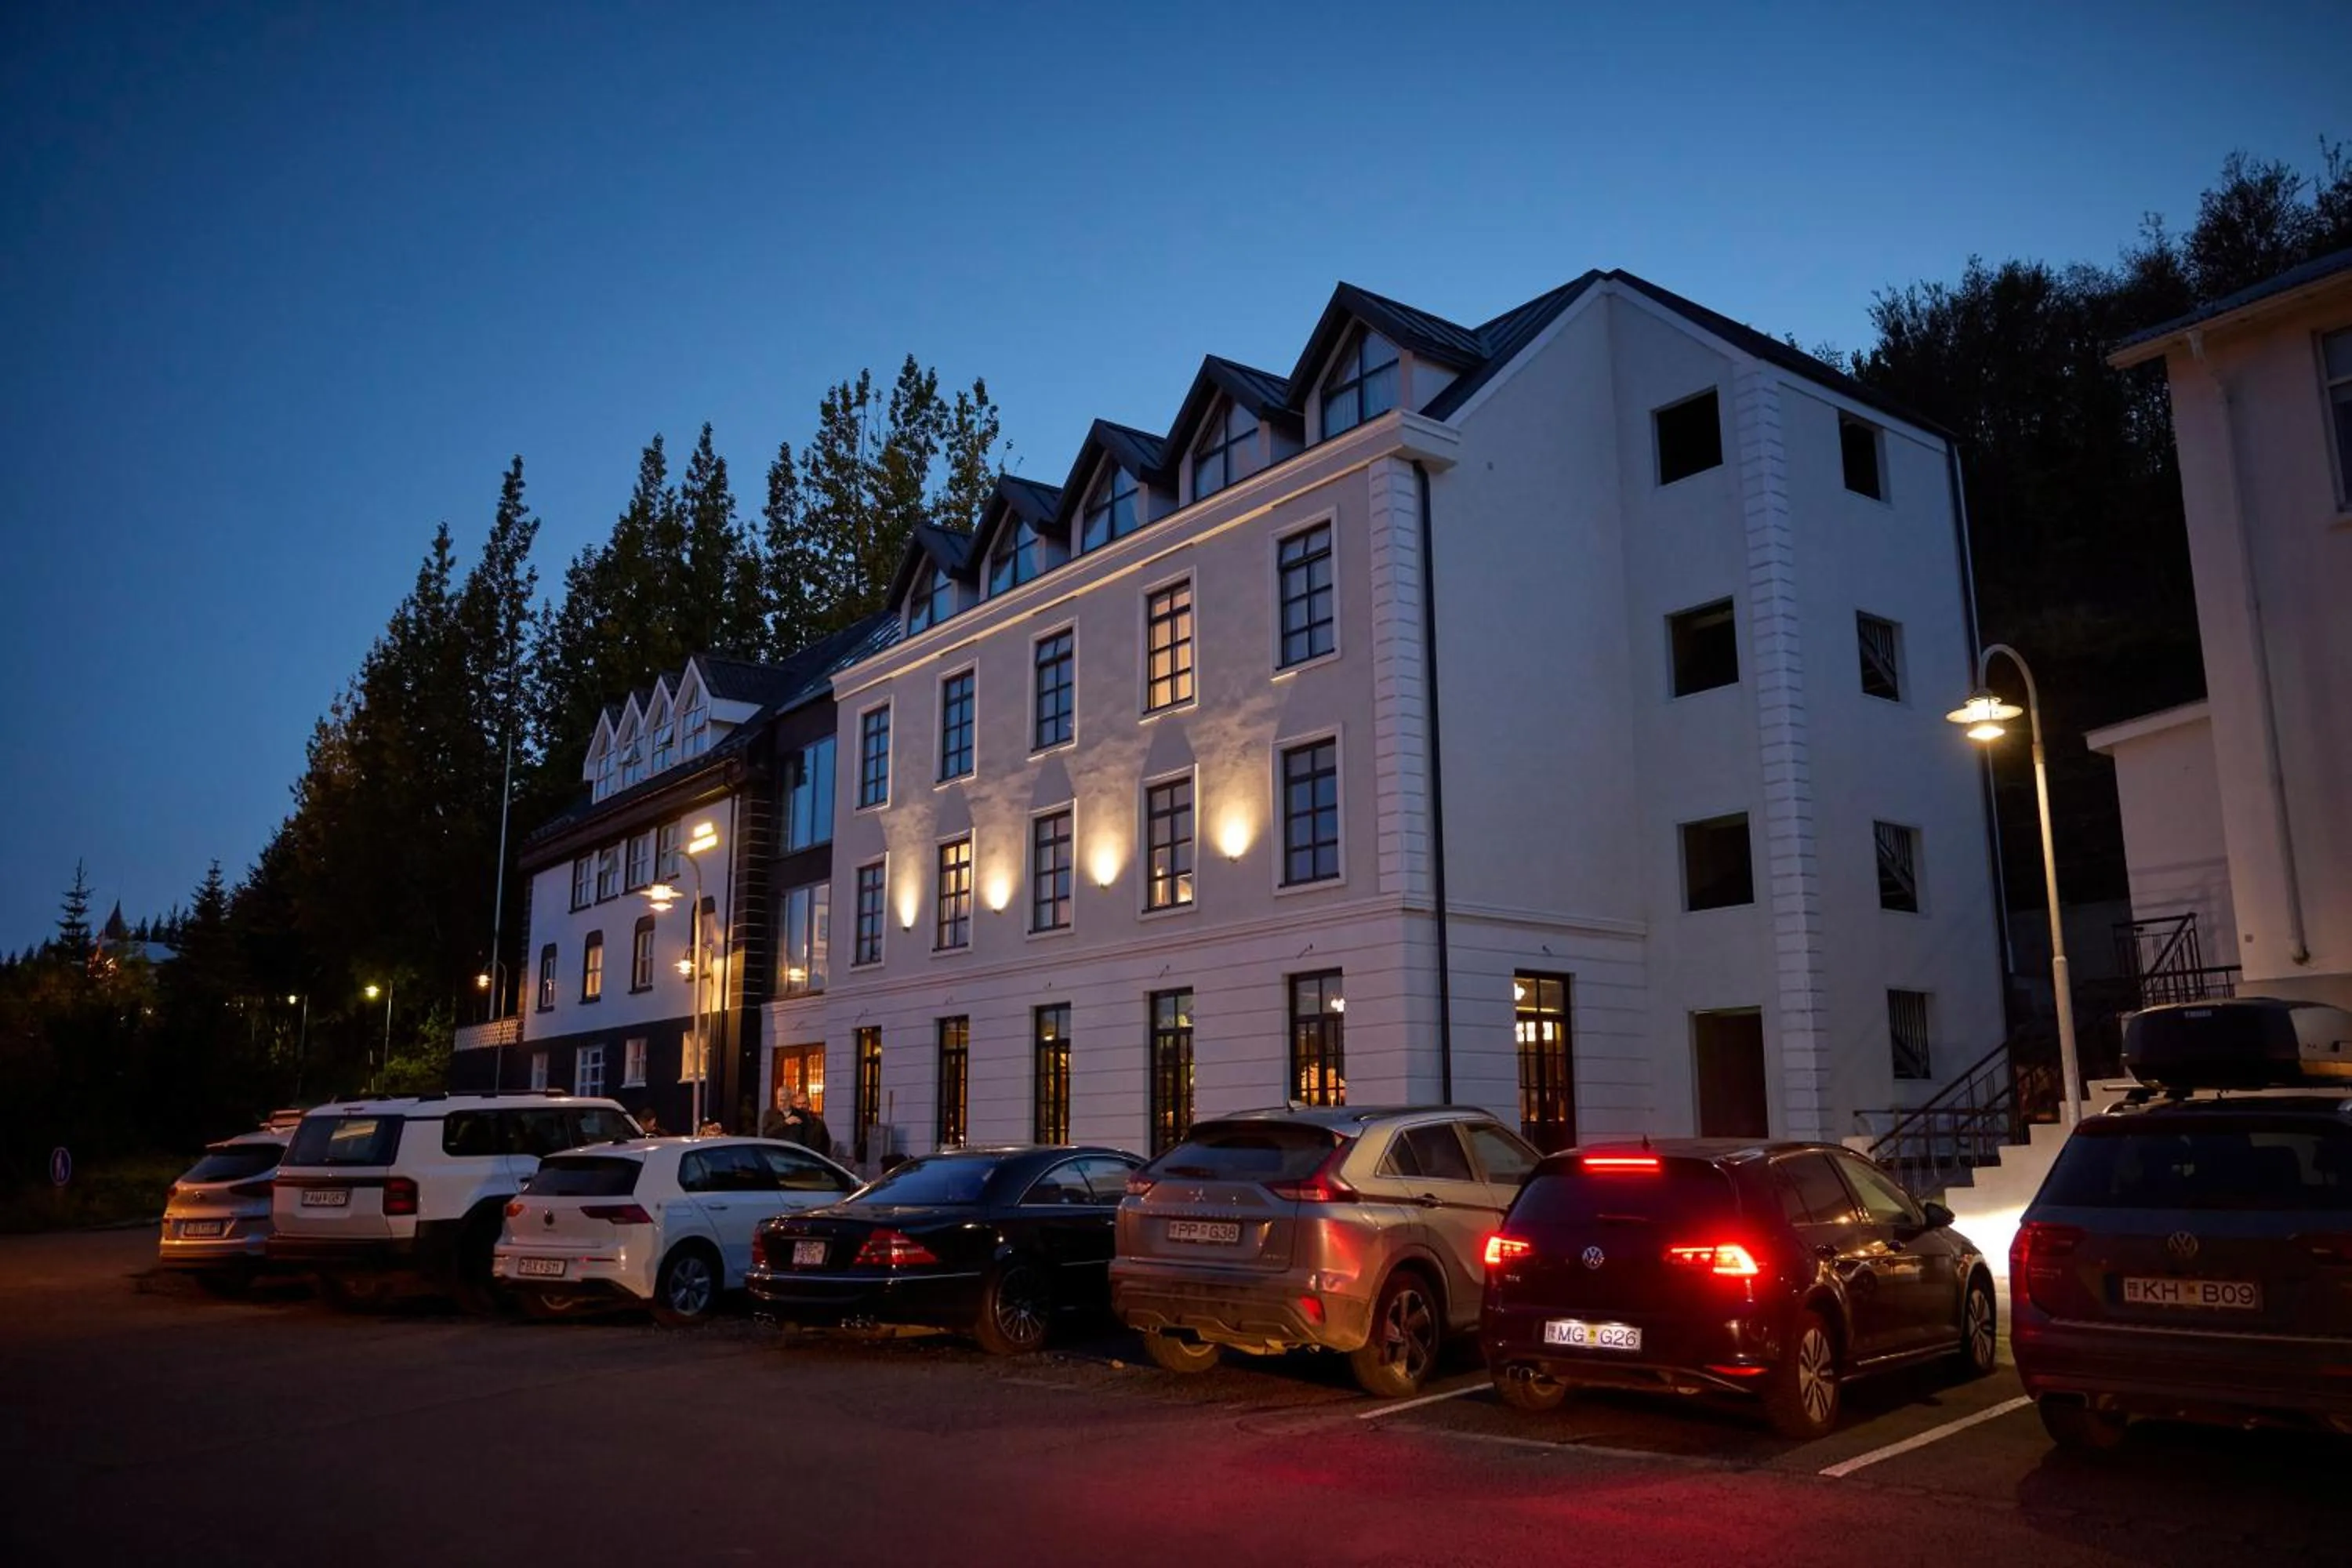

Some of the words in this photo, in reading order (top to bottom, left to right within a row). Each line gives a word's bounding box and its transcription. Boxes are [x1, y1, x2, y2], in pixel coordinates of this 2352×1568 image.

[1178, 1224, 1199, 1236] PP
[2143, 1281, 2179, 1301] KH
[2202, 1283, 2253, 1305] B09
[1557, 1325, 1584, 1342] MG
[1600, 1329, 1636, 1346] G26
